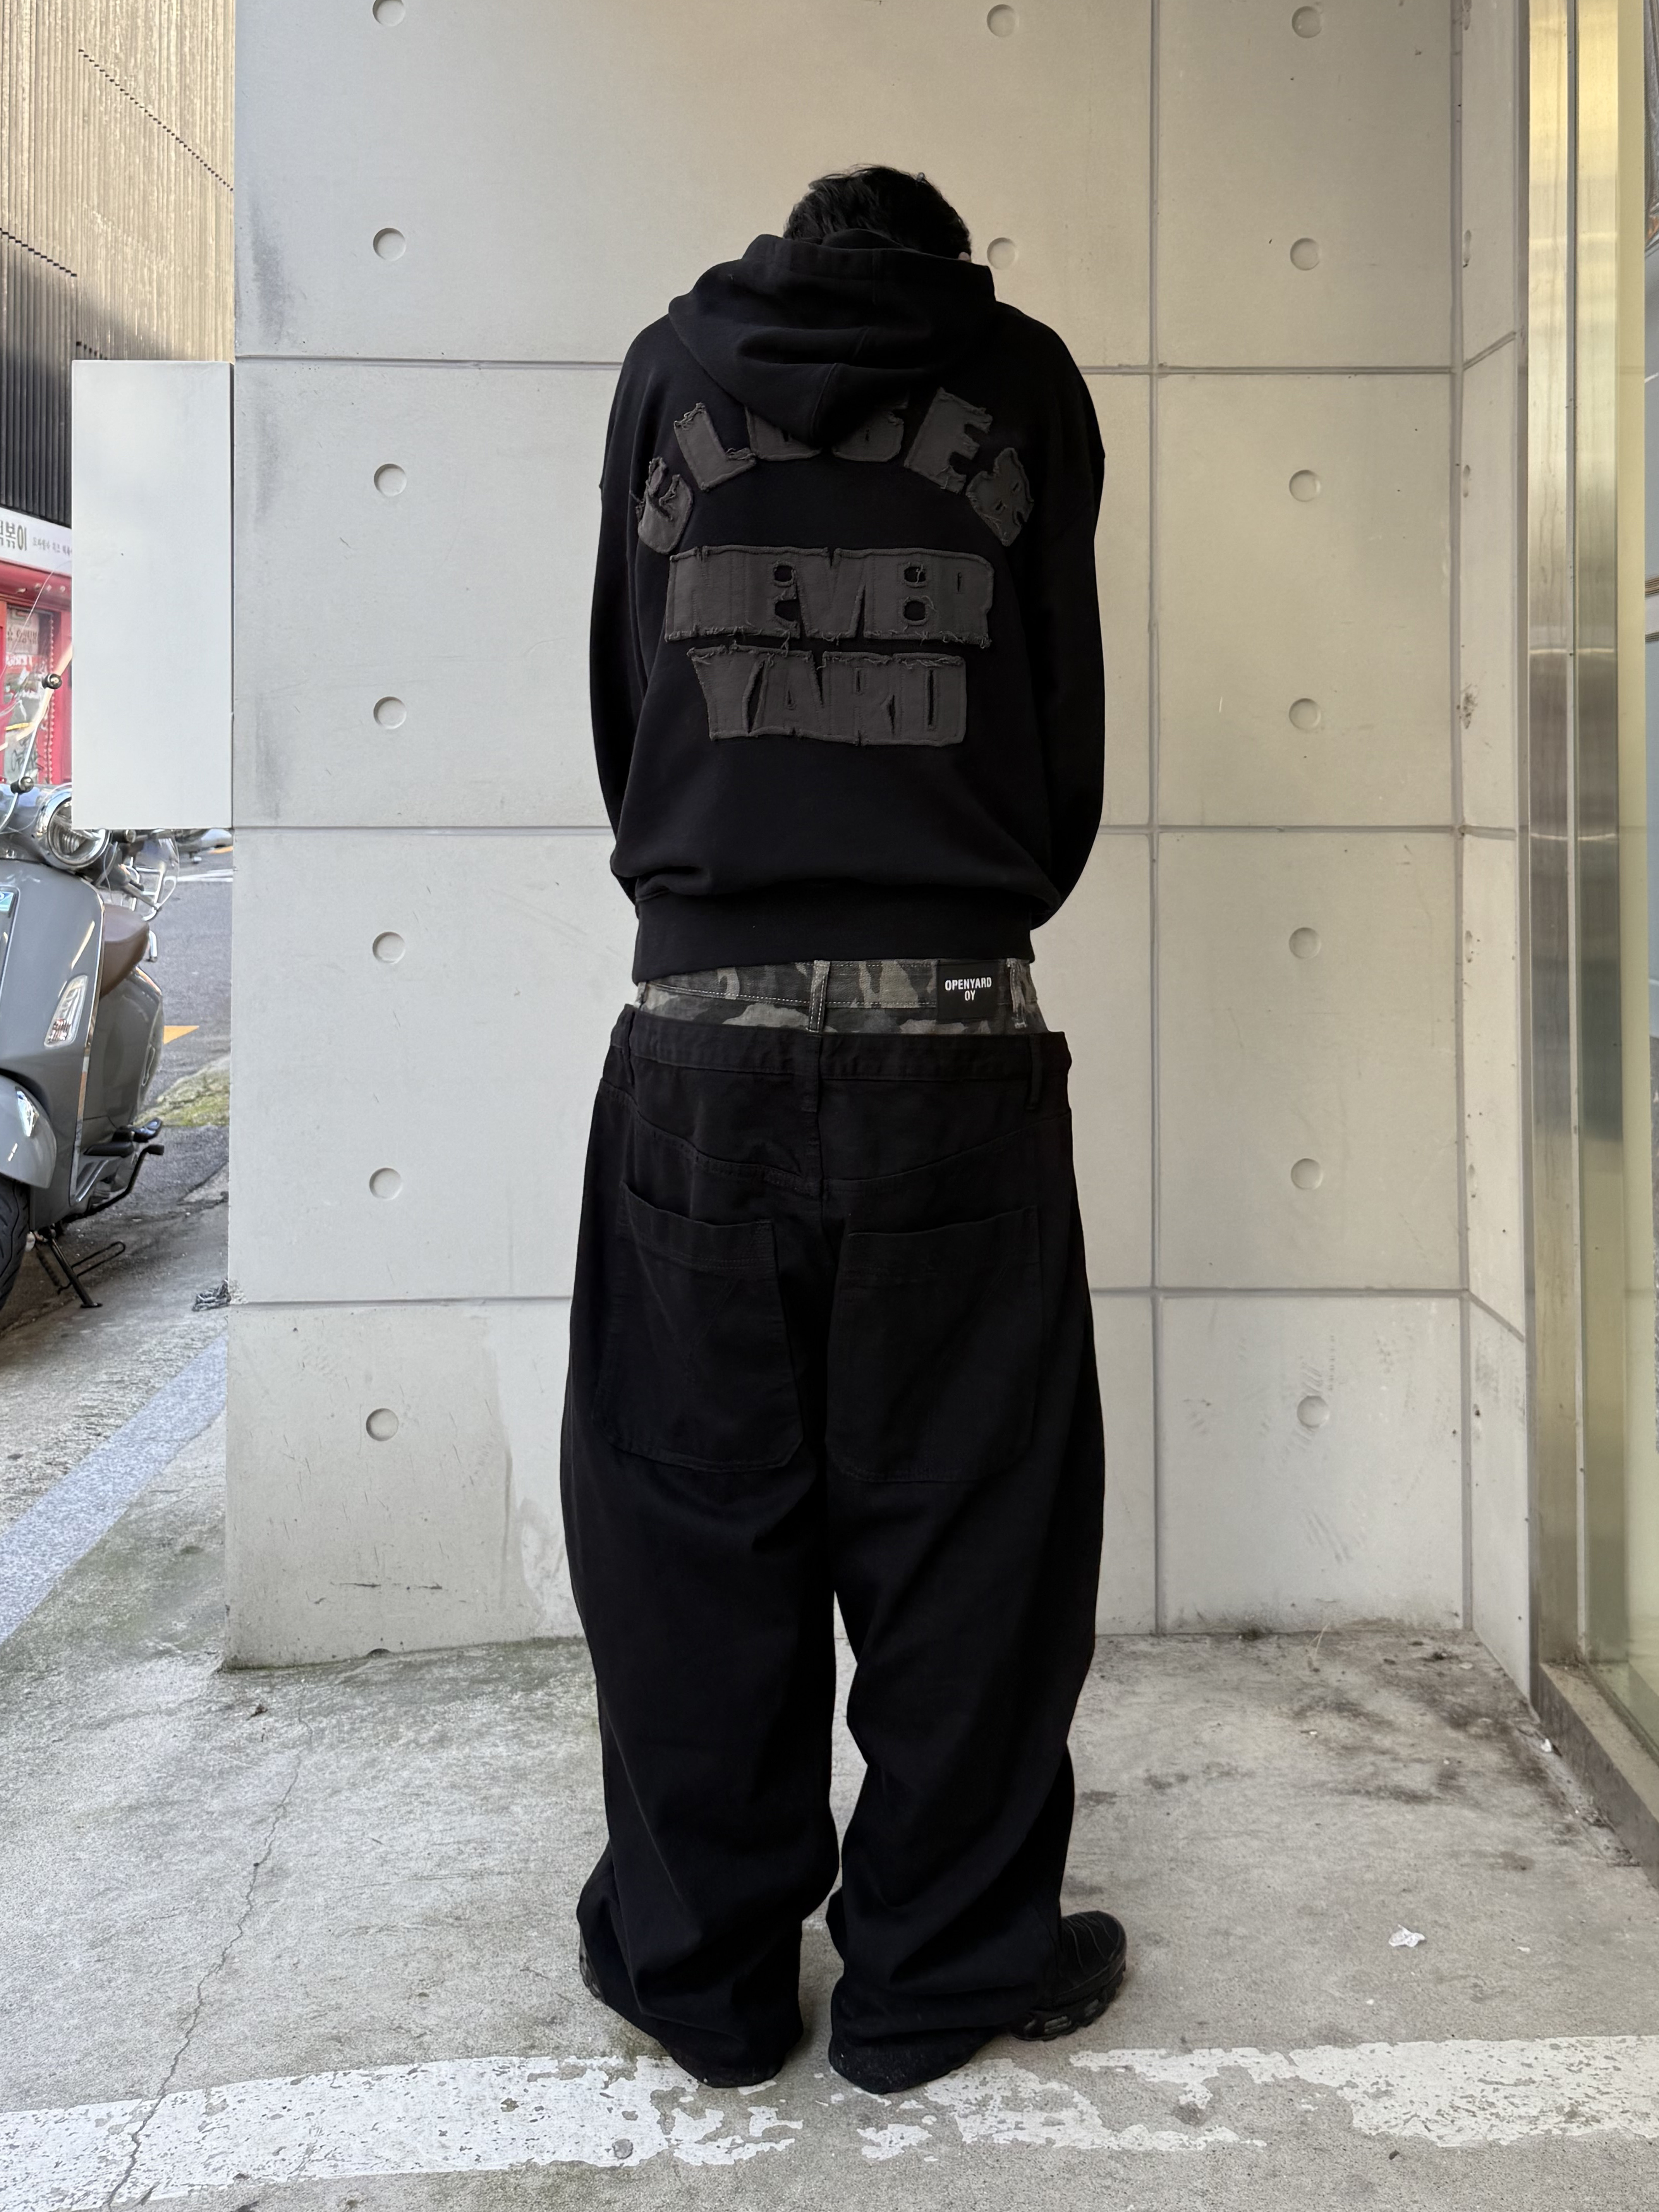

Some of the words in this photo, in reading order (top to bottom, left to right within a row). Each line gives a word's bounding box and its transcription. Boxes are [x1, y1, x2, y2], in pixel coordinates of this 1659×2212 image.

[687, 643, 967, 747] YARD
[945, 977, 992, 991] OPENYARD
[964, 990, 975, 1001] OY
